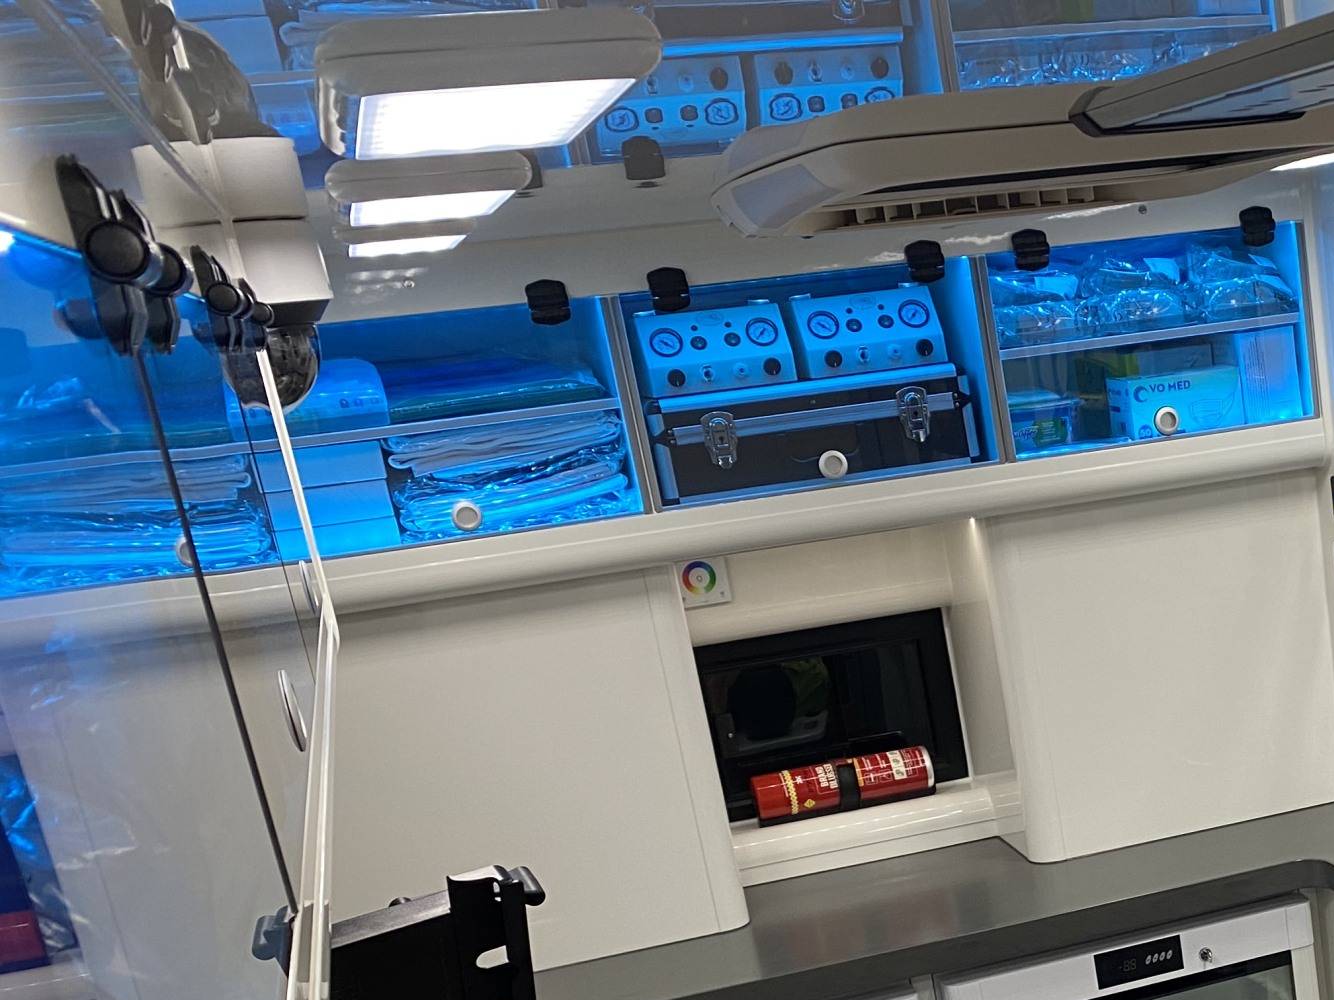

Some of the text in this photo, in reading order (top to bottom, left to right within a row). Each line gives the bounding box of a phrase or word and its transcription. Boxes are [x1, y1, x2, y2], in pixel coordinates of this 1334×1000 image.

[1149, 379, 1191, 393] VO MED
[815, 766, 829, 787] BRAND
